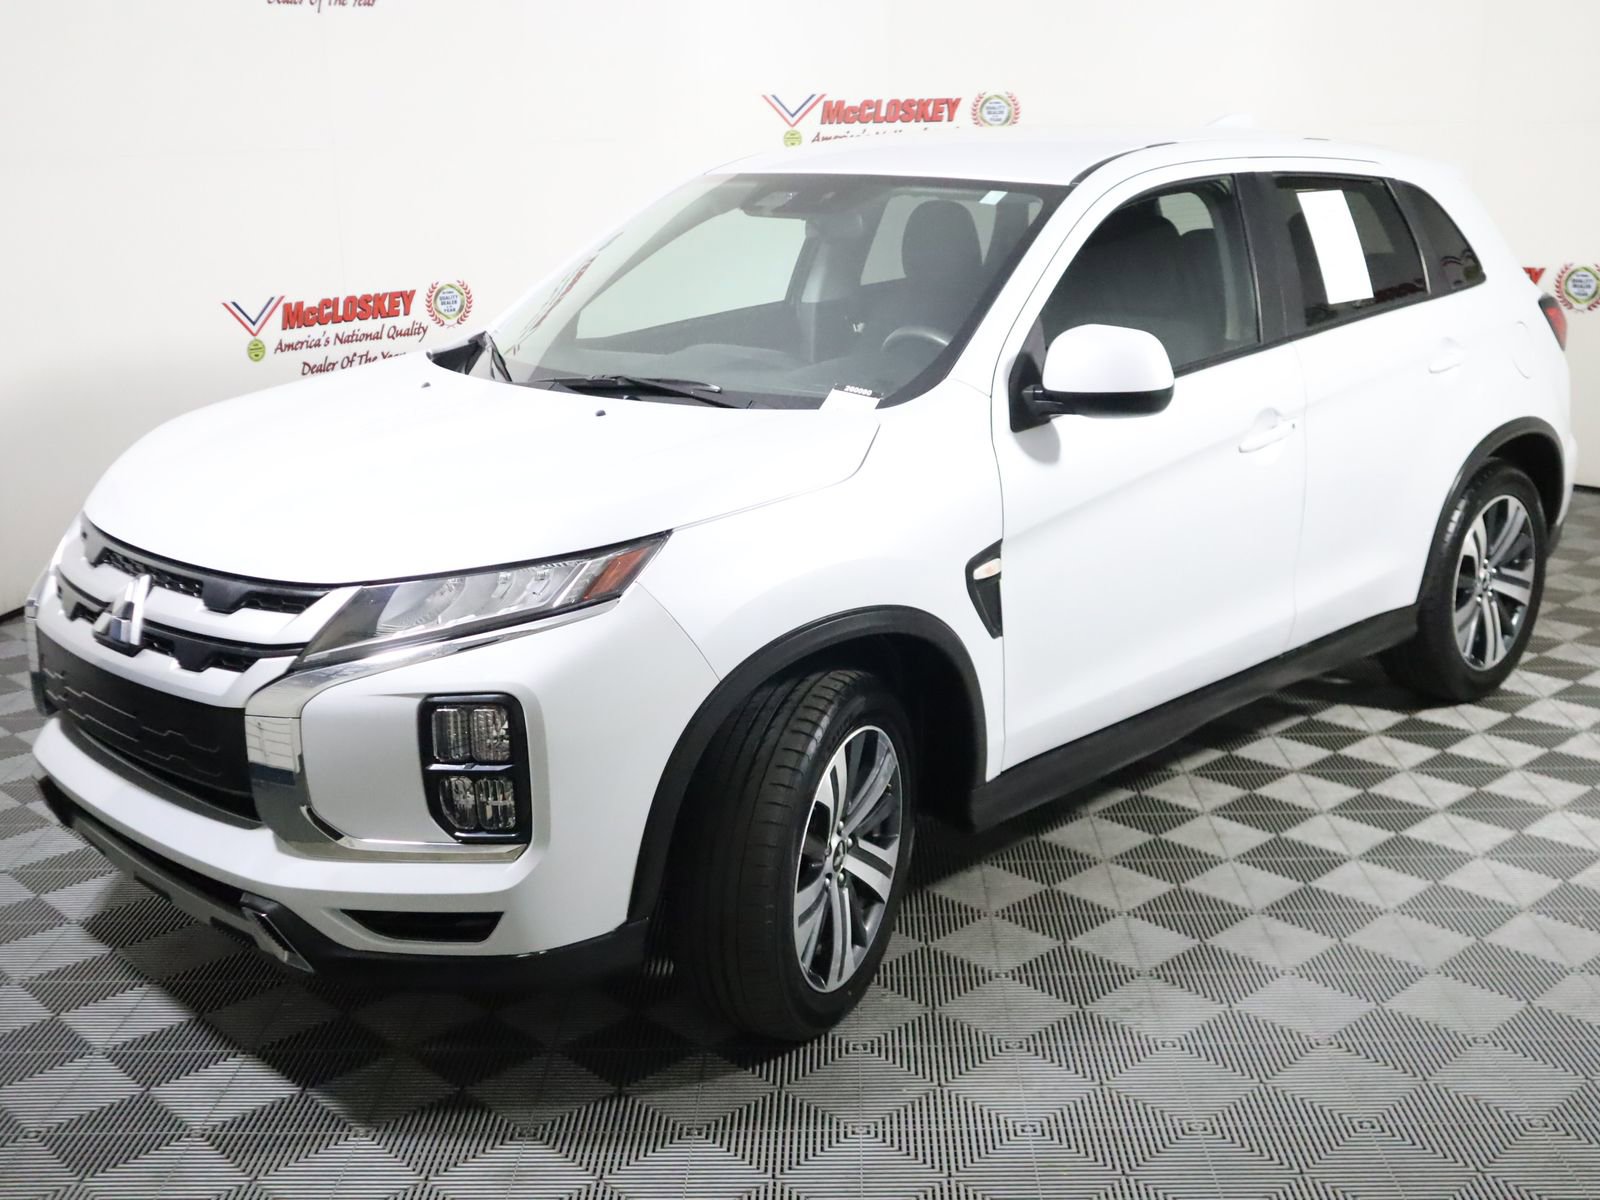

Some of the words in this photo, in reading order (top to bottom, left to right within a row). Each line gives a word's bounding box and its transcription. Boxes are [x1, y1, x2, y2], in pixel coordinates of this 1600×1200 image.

[820, 97, 962, 125] McCLOSKEY
[281, 289, 417, 331] McCLOSKEY
[273, 330, 331, 355] America's
[333, 323, 384, 346] National
[386, 320, 430, 343] Quality
[301, 353, 339, 376] Dealer
[341, 352, 357, 370] Of
